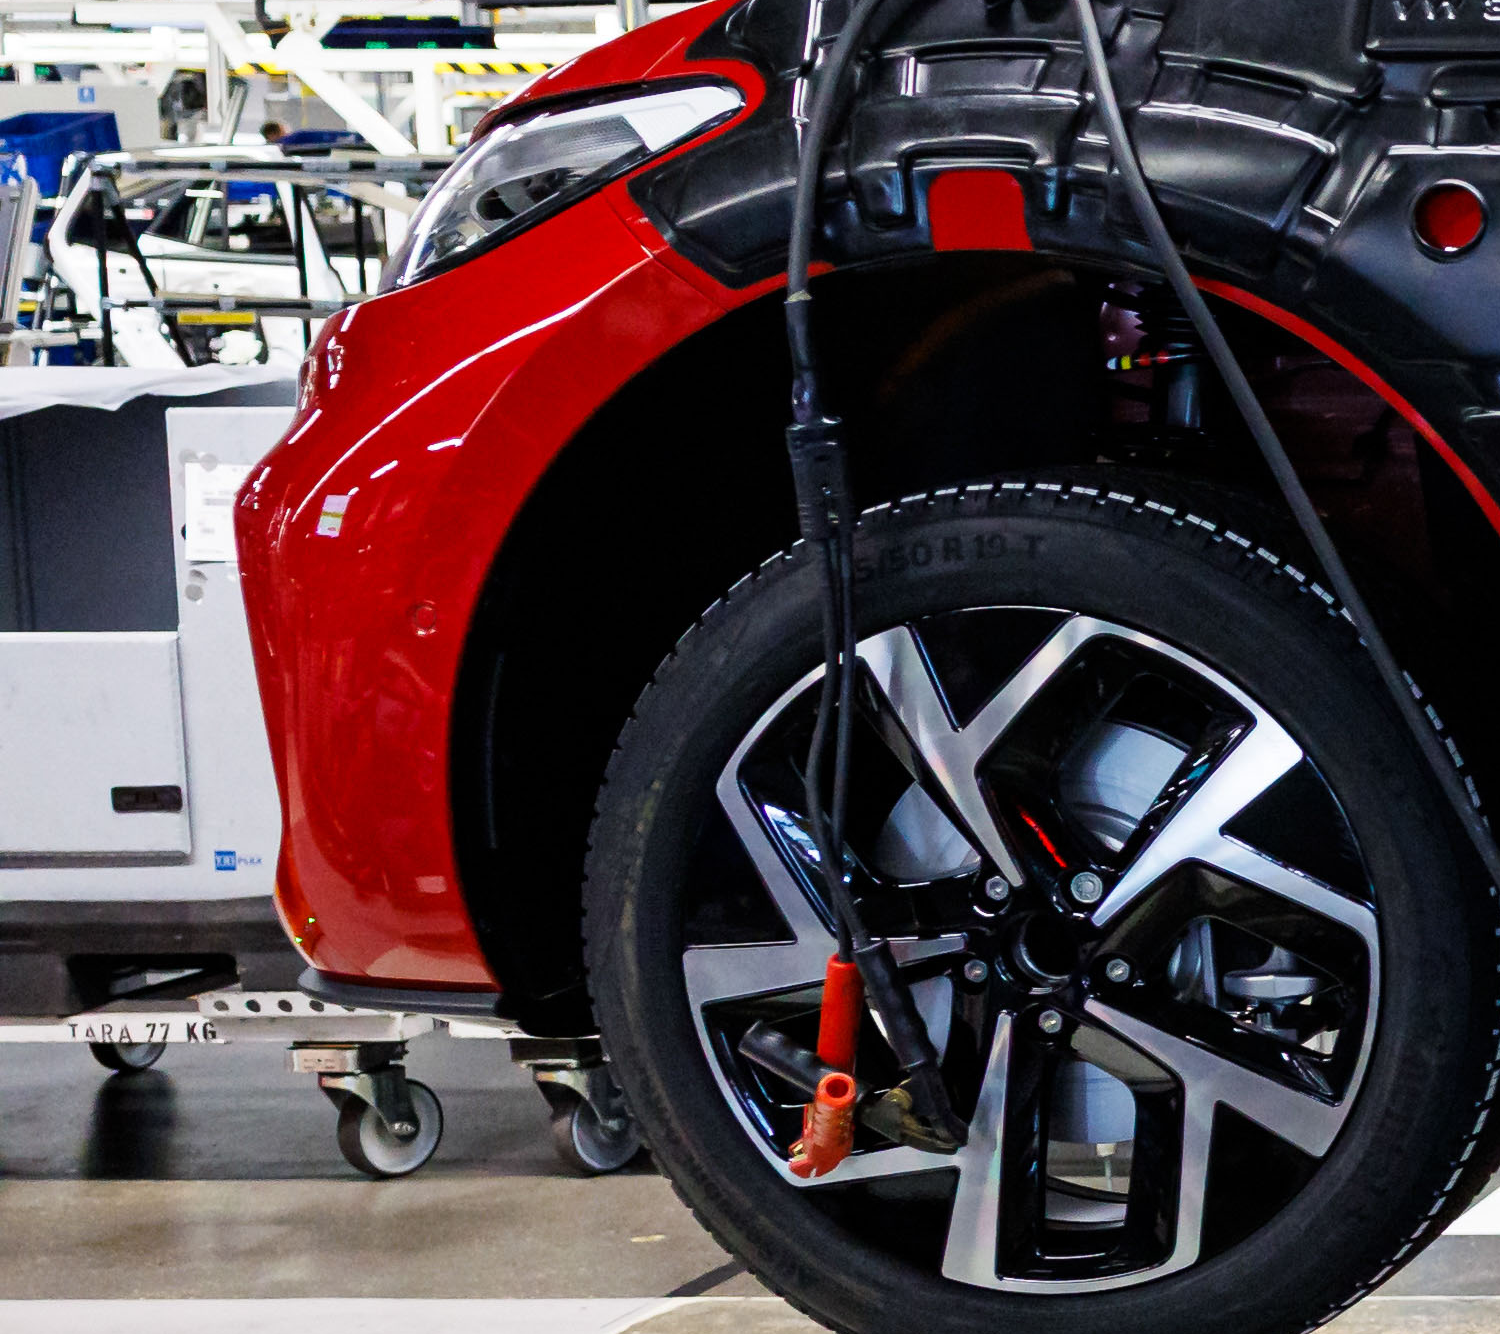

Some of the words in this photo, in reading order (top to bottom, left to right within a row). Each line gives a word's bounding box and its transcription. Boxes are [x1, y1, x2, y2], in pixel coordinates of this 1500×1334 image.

[67, 1022, 133, 1043] TARA
[145, 1022, 171, 1043] 77
[186, 1021, 218, 1043] KG
